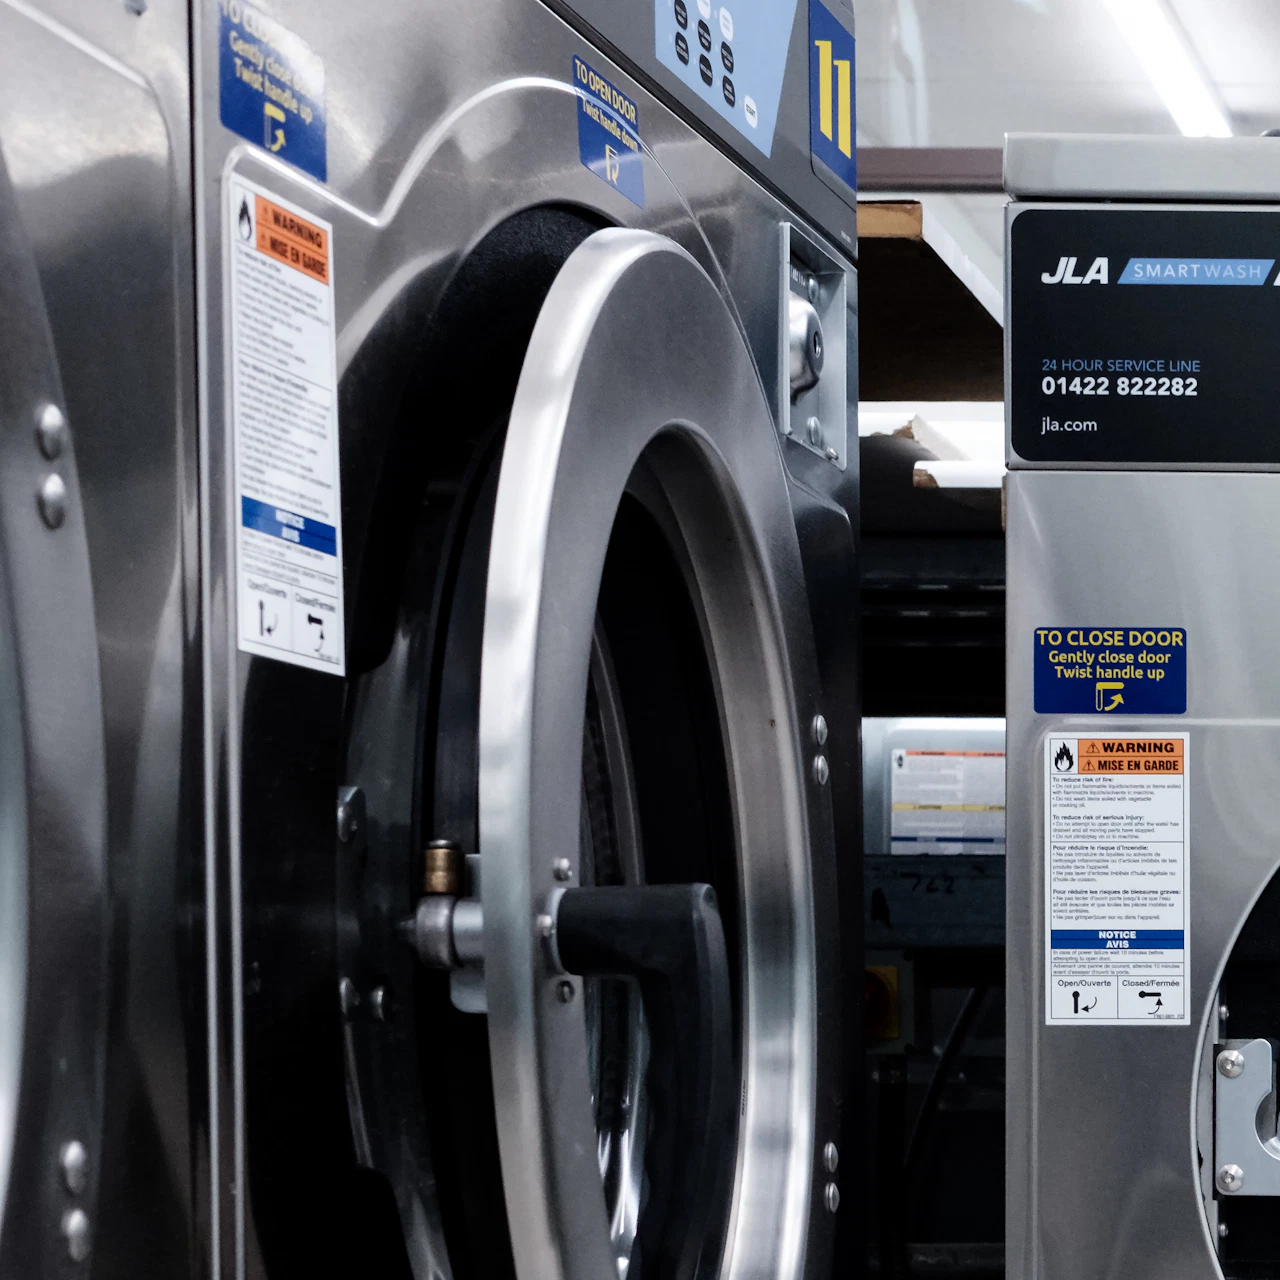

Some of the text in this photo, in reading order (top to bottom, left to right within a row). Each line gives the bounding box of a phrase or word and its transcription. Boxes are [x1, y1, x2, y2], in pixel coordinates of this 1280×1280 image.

[229, 30, 264, 71] Gently
[234, 57, 264, 93] Twist
[264, 75, 299, 114] handle
[300, 104, 313, 125] up
[575, 58, 637, 125] TO OPEN DOOR
[815, 40, 851, 159] 11
[582, 97, 639, 153] Twist handle down
[272, 209, 322, 249] WARNING
[290, 246, 300, 265] EN
[302, 252, 326, 278] GARDE
[1041, 257, 1109, 285] JLA
[1042, 359, 1200, 372] 24 HOUR SERVICE LINE
[1041, 376, 1198, 396] 01422 822282
[1041, 416, 1098, 435] jla.com
[1037, 630, 1183, 646] TO CLOSE DOOR
[1049, 650, 1171, 665] Gently close door
[1054, 665, 1165, 681] Twist handle up
[1102, 742, 1174, 753] WARNING
[1098, 760, 1179, 771] MISE EN GARDE
[1098, 931, 1136, 939] NOTICE
[1106, 940, 1129, 948] AVIS
[1057, 980, 1112, 988] Open/Ouverte
